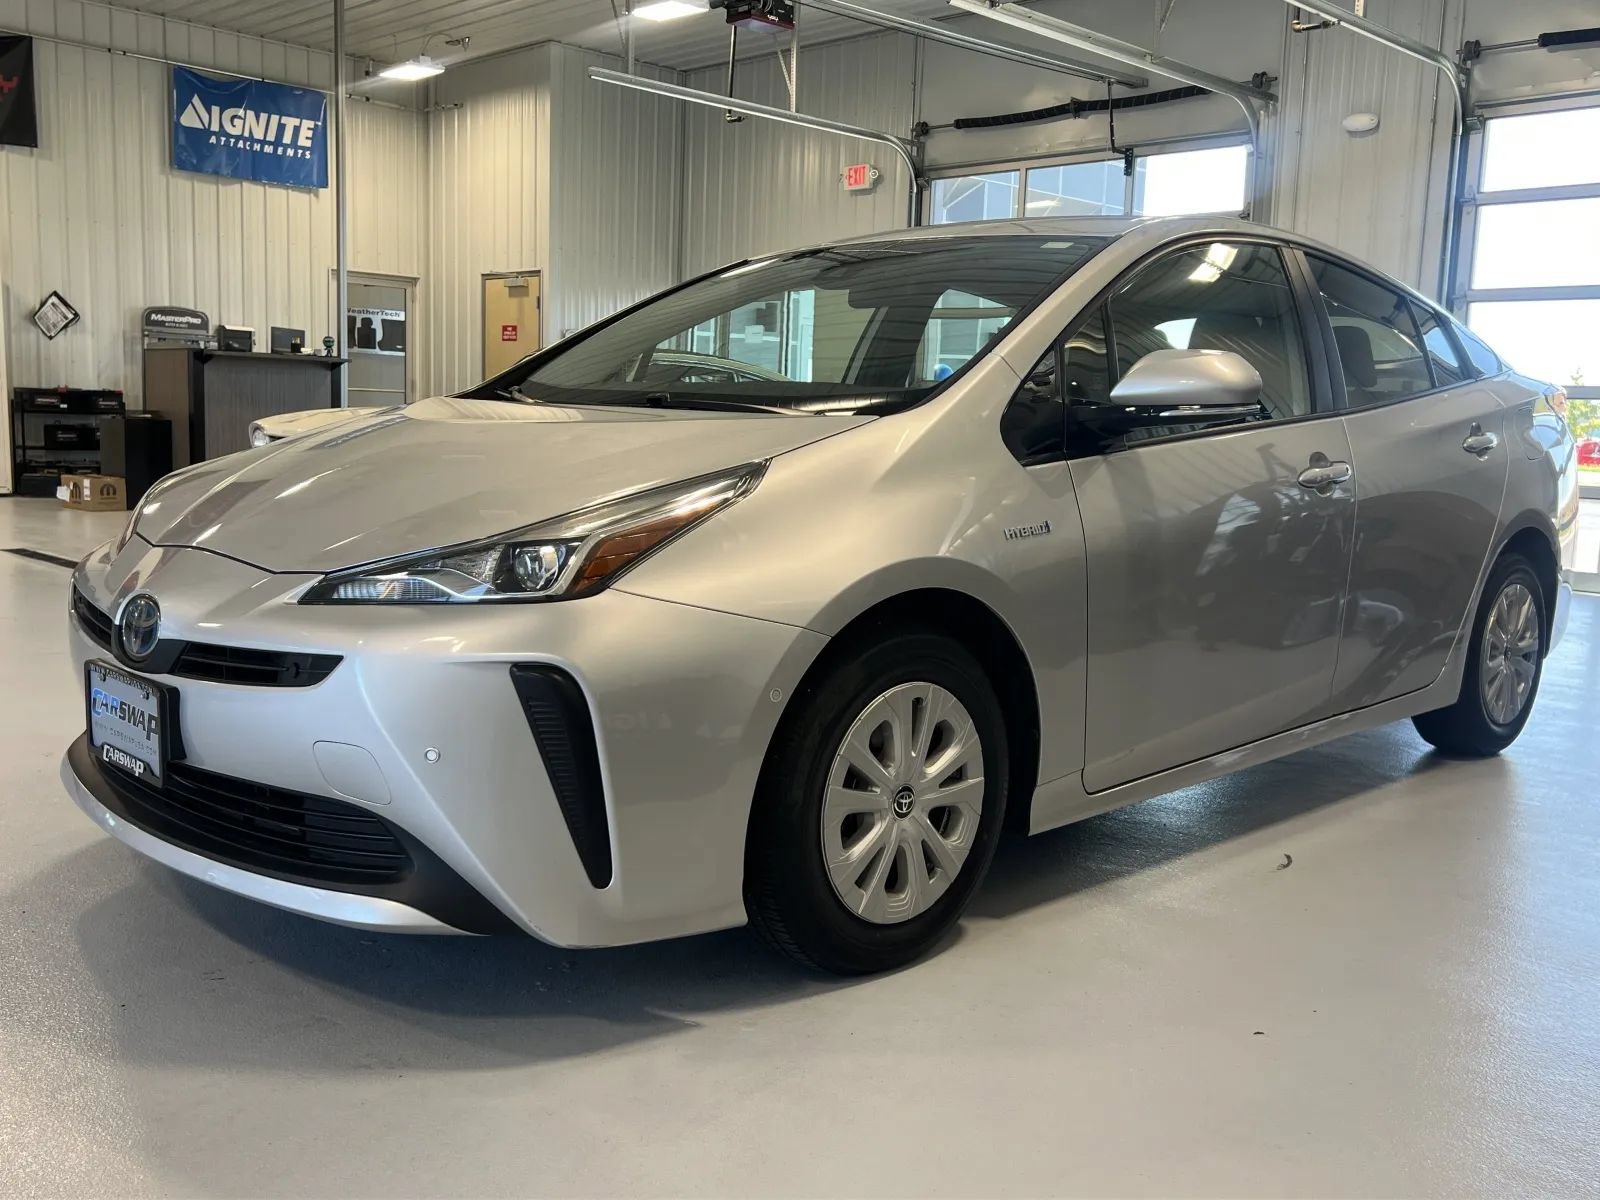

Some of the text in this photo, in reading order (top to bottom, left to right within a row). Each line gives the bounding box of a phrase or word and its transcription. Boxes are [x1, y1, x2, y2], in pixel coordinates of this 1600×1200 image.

[210, 105, 315, 148] IGNITE
[209, 135, 311, 159] ATTACHMENTS
[848, 167, 865, 186] EXIT
[1004, 521, 1048, 540] HYBRID
[92, 688, 160, 741] CARSWAP
[103, 744, 145, 777] CARSWAP
